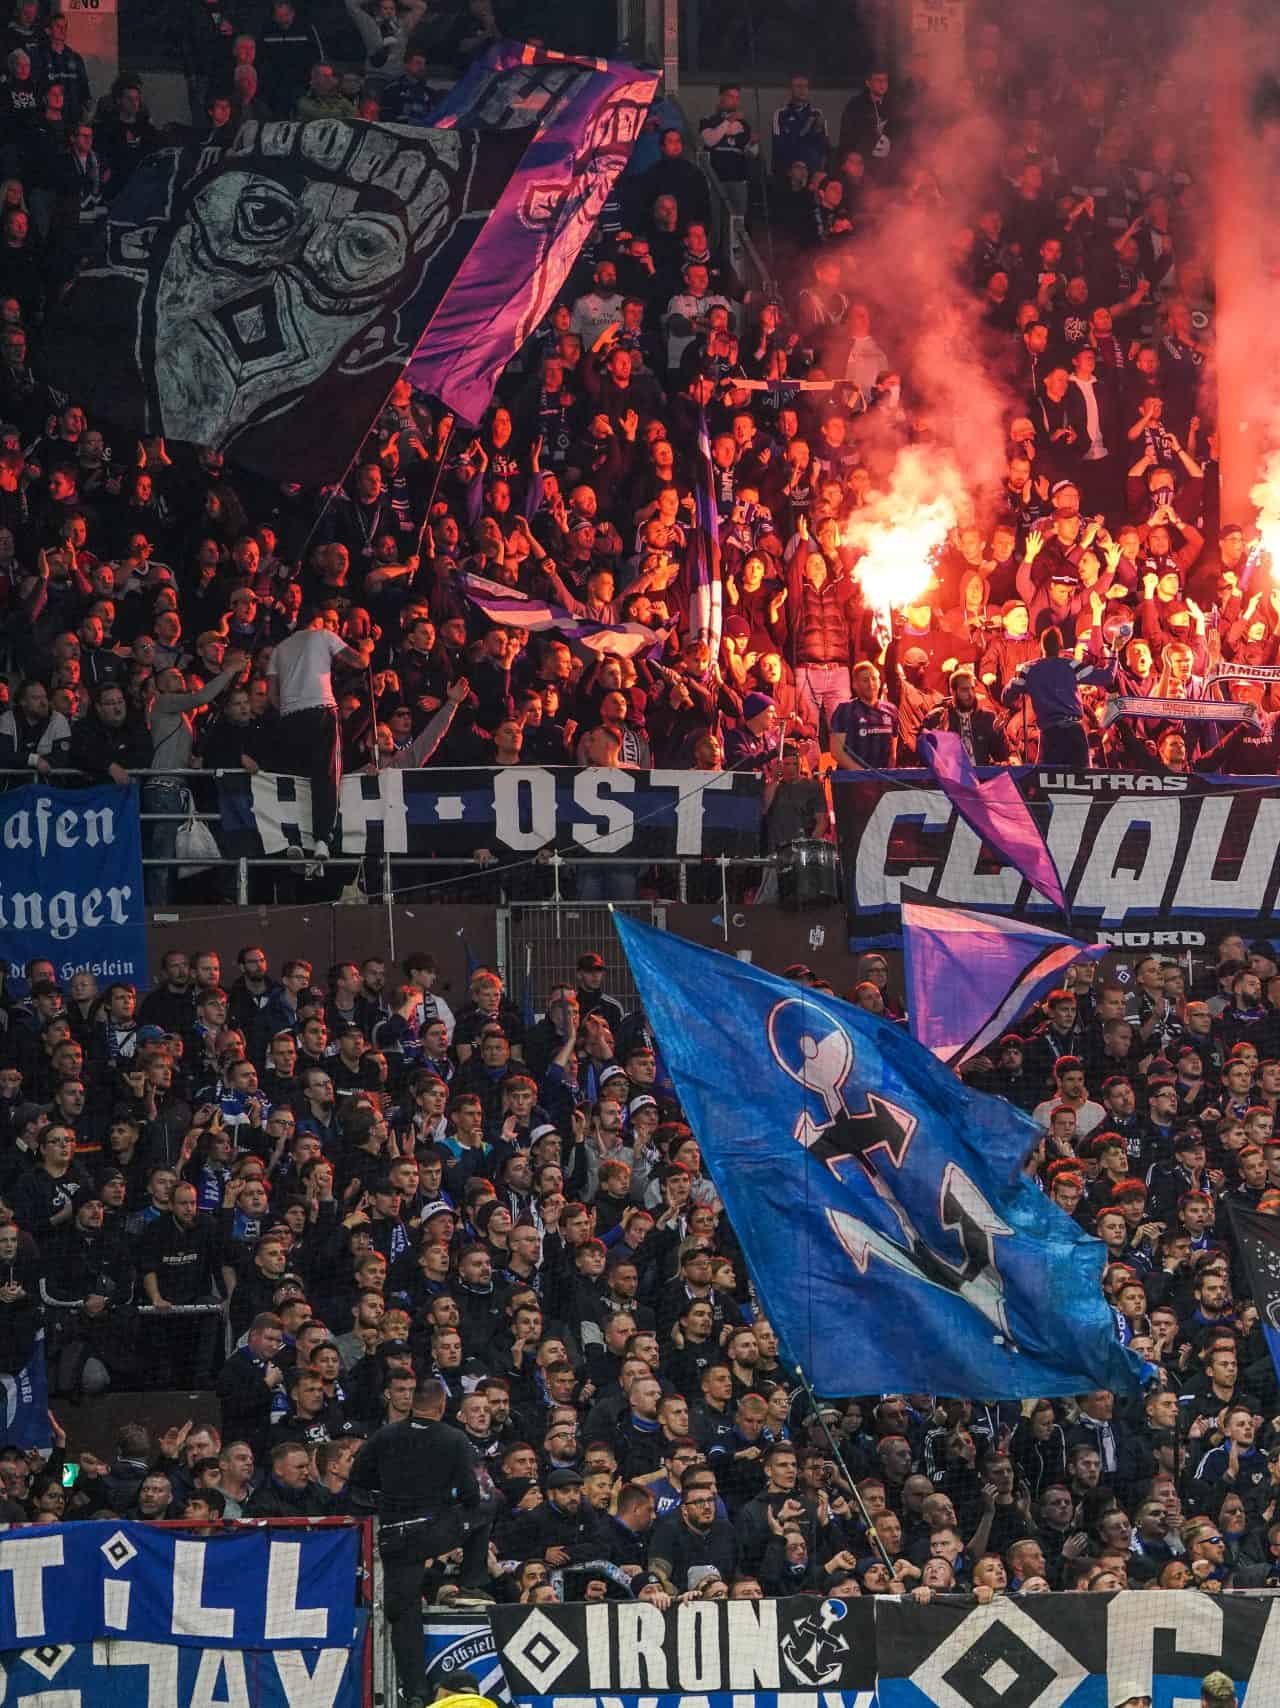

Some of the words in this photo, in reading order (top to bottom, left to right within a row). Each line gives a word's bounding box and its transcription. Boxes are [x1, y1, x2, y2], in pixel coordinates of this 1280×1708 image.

[1039, 772, 1189, 792] ULTRAS
[1097, 930, 1206, 947] NORD
[584, 1599, 783, 1692] IRON
